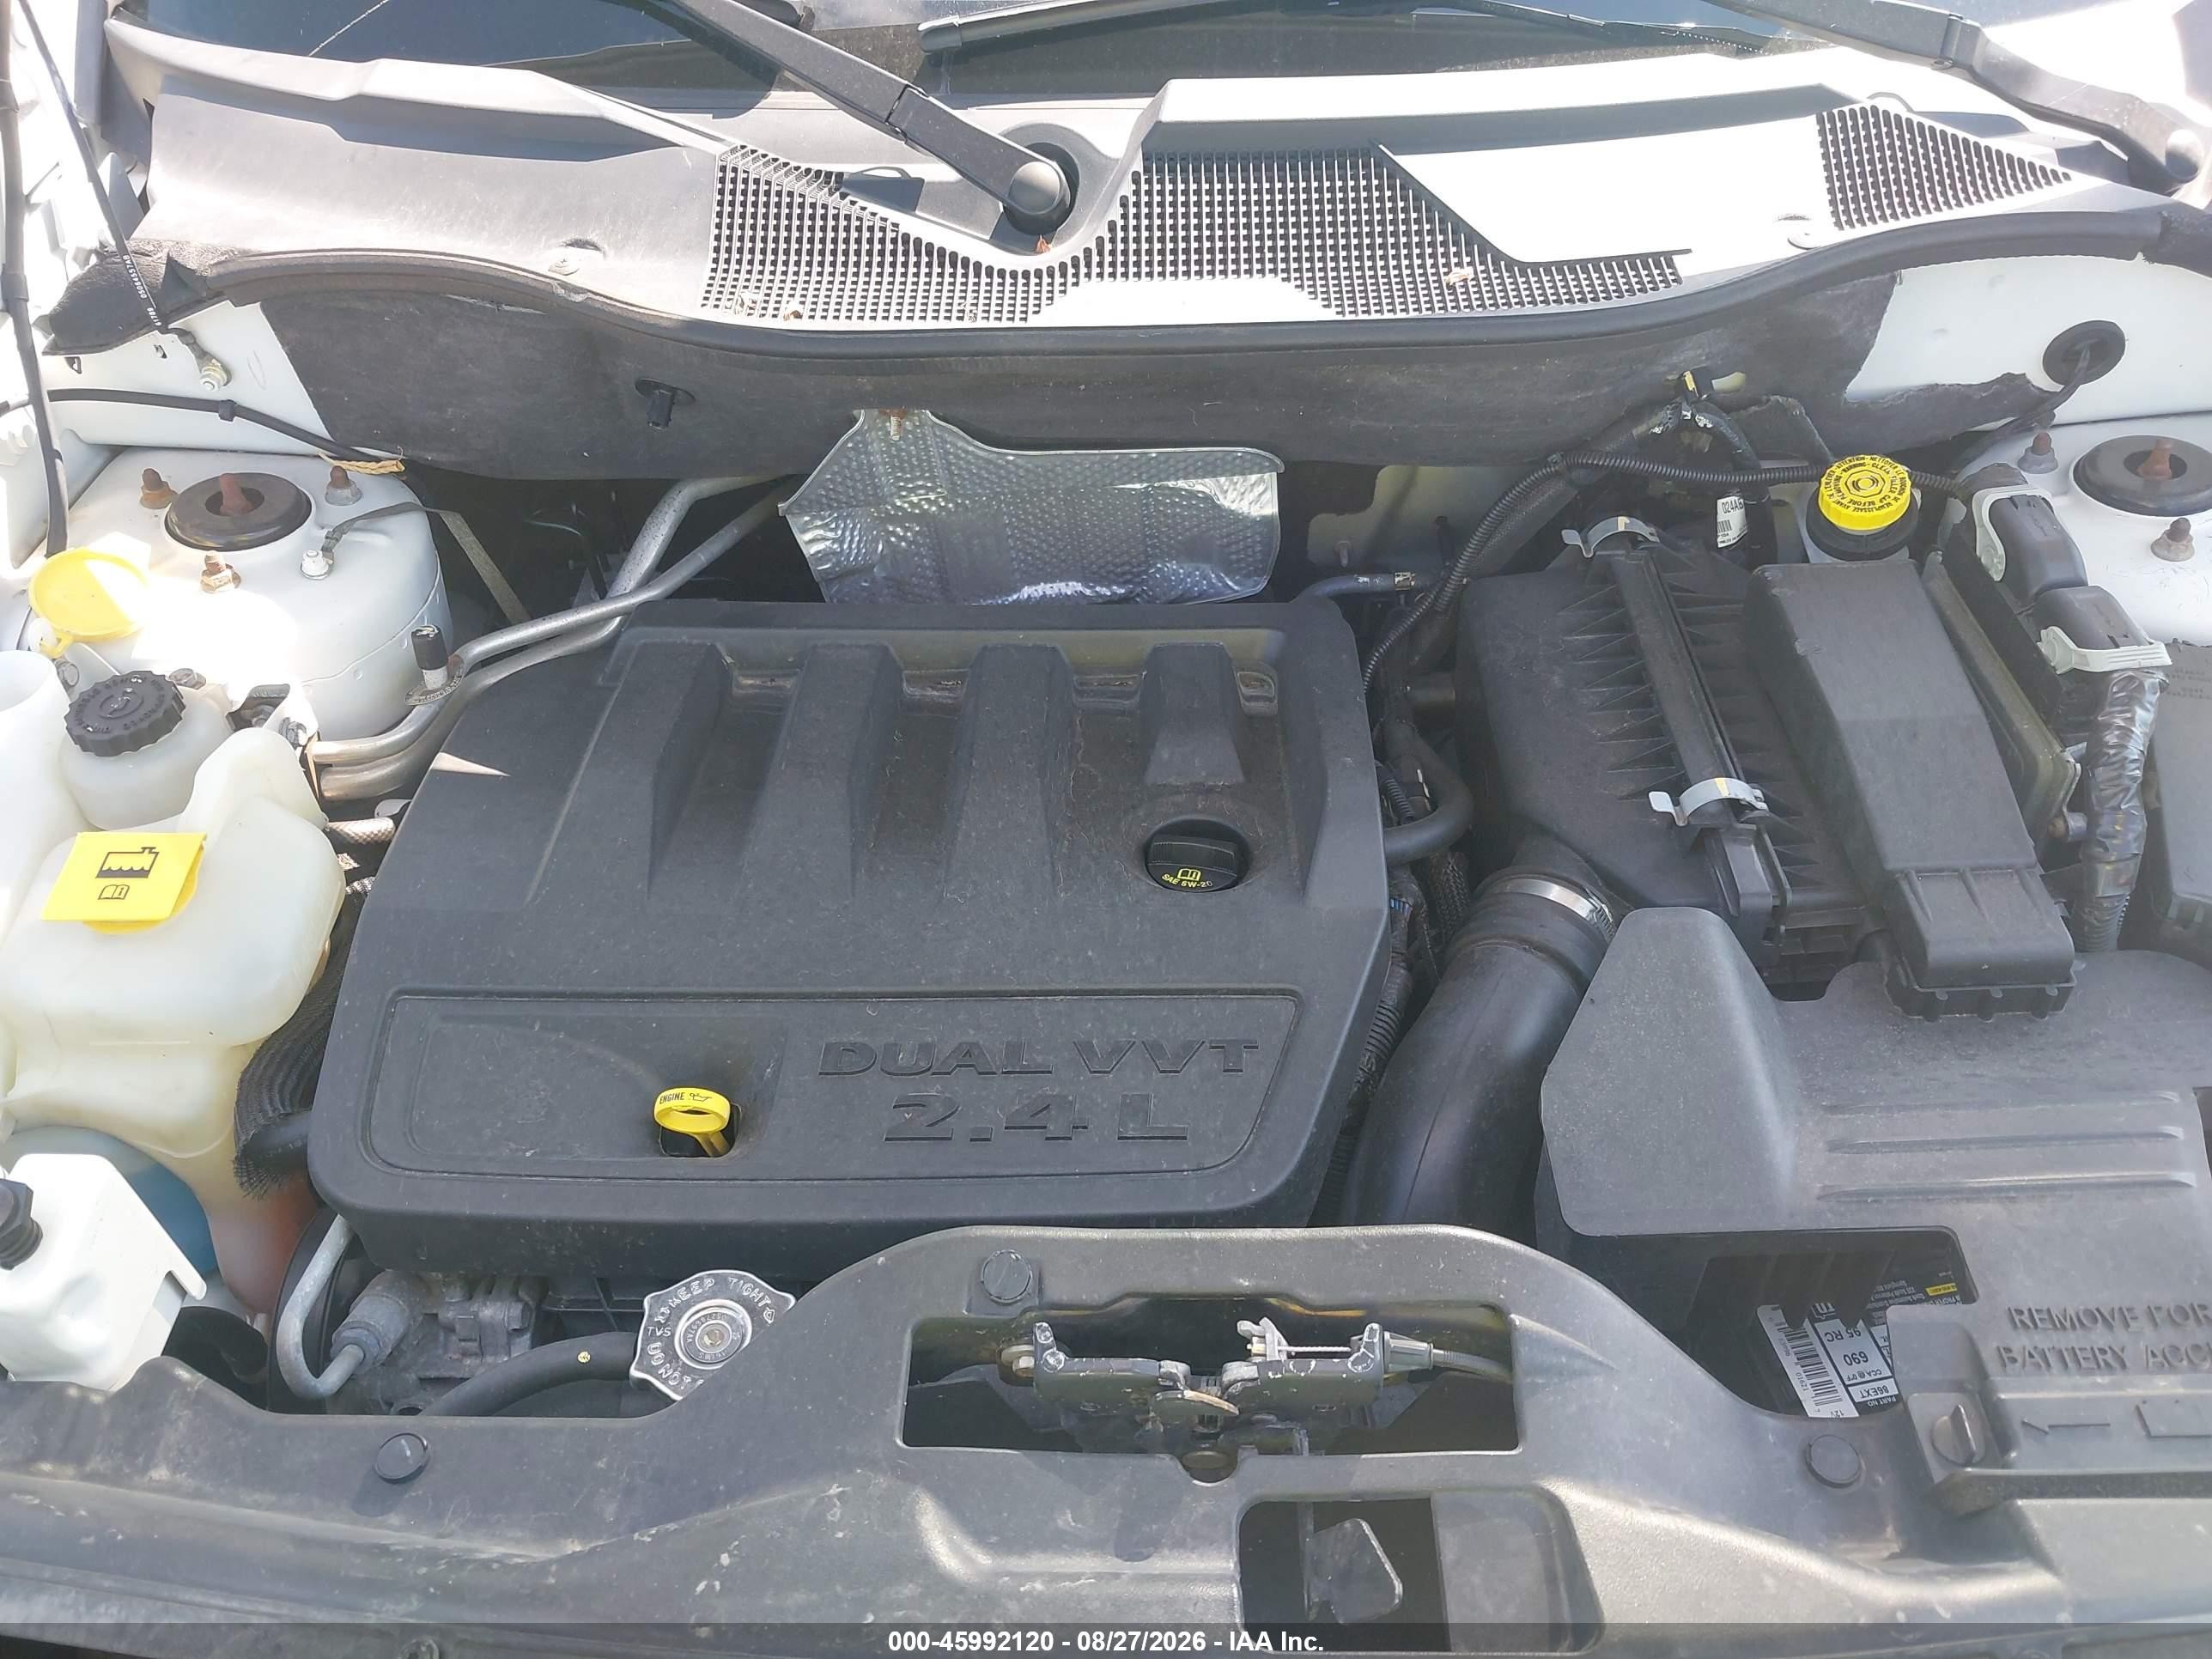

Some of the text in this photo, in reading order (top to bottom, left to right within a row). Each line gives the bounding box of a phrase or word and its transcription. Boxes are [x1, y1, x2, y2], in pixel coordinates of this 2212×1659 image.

[1847, 498, 1876, 507] BEFORE
[1162, 873, 1180, 884] SAE
[818, 1039, 1259, 1076] DUAL VVT
[659, 1091, 685, 1104] ENGINE
[884, 1092, 1089, 1142] 2.4
[727, 1276, 771, 1307] TIGHT
[2007, 1302, 2212, 1332] REMOVE FOR
[647, 1326, 672, 1337] TVS
[1824, 1327, 1862, 1342] 95 RC
[1843, 1351, 1869, 1366] 690
[1996, 1341, 2212, 1370] BATTERY ACC
[1866, 1369, 1882, 1377] CCA
[1859, 1384, 1890, 1399] 86EXT
[1879, 1395, 1896, 1405] PART
